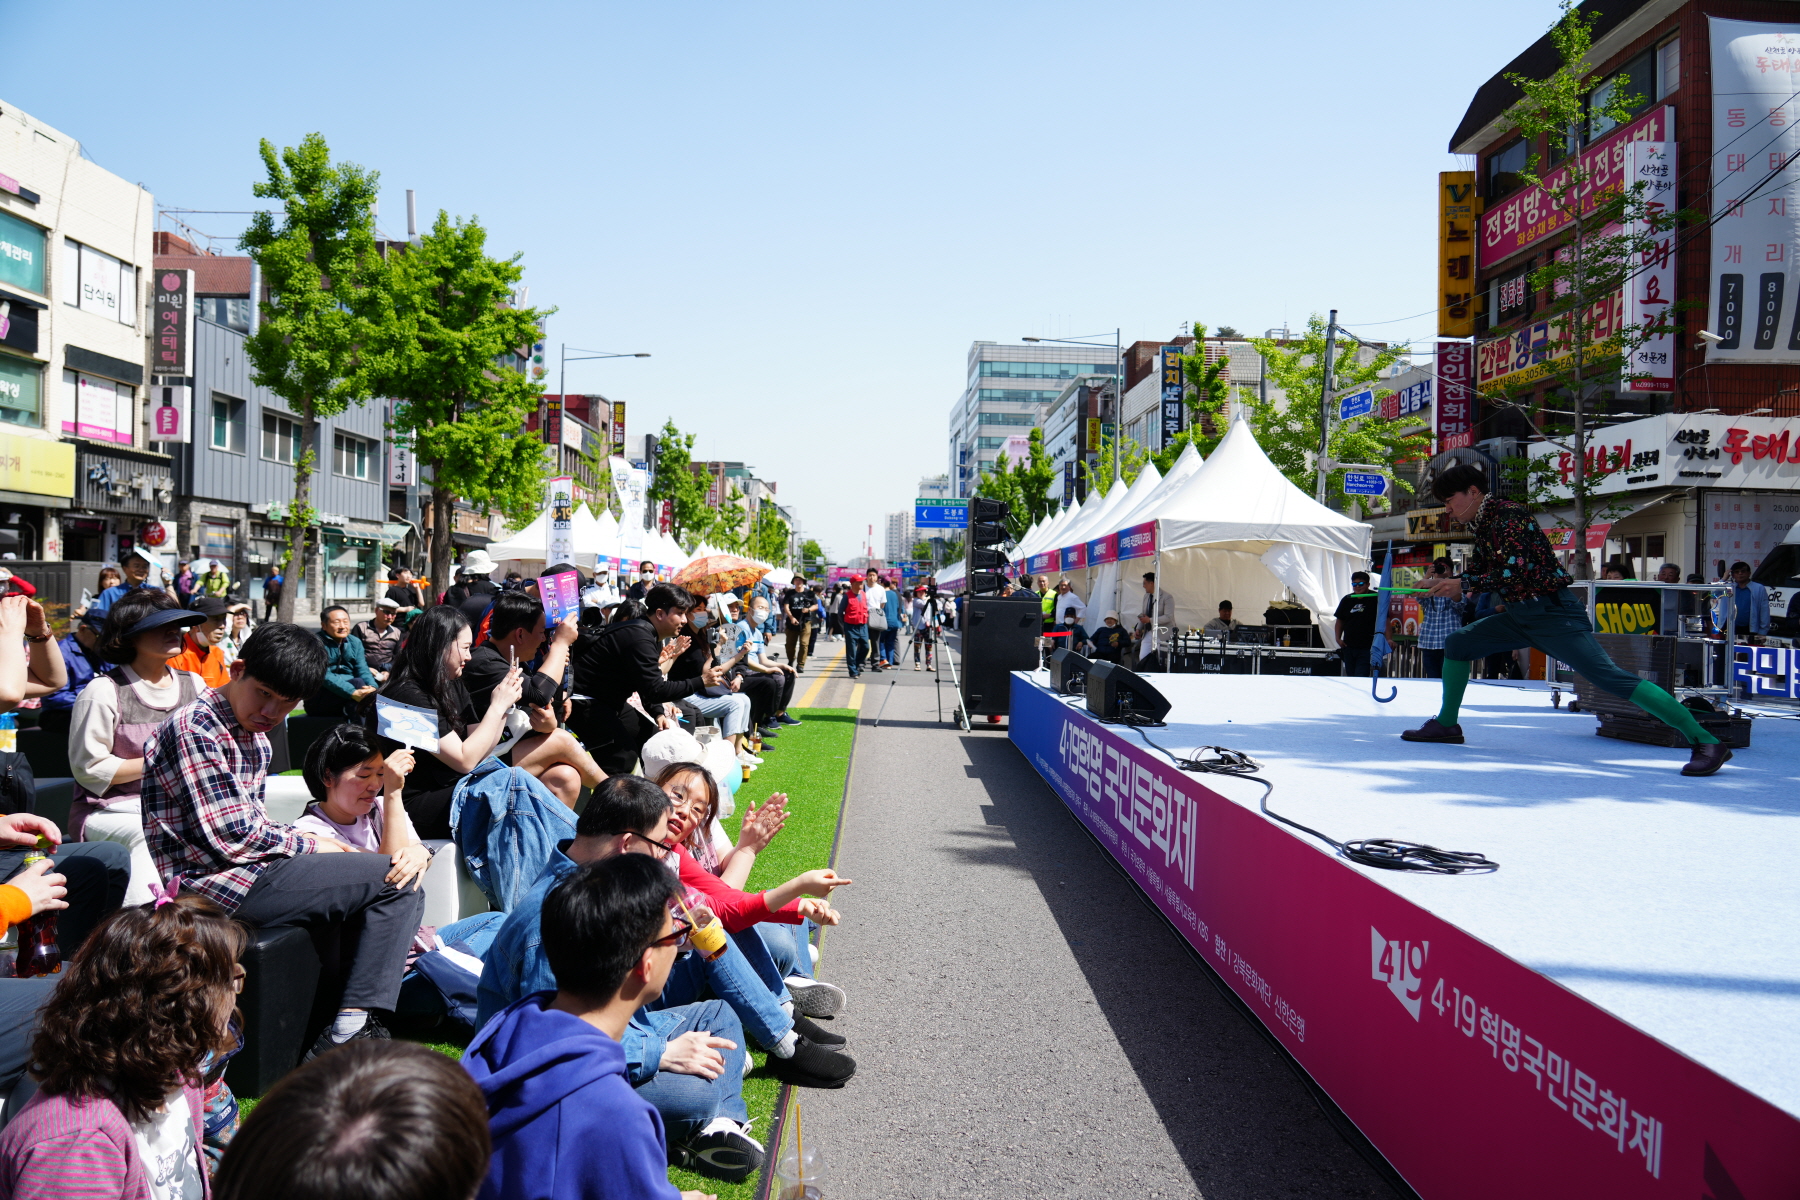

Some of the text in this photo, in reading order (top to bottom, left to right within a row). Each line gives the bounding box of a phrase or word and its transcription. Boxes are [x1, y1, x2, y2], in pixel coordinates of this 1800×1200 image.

[1639, 164, 1669, 177] 산천골
[0, 240, 32, 266] 체관리
[158, 294, 183, 309] 미원
[1500, 274, 1524, 312] 전화방
[161, 311, 178, 364] 에스테틱
[1638, 351, 1667, 364] 전문점
[1441, 343, 1467, 437] 성인전화방
[163, 409, 172, 432] NAIL
[1445, 434, 1469, 449] 7080
[944, 508, 964, 517] 도봉로
[1773, 504, 1800, 513] 25,000
[1596, 602, 1655, 634] SHOW
[1733, 646, 1800, 698] 국민
[1104, 744, 1198, 892] 국민문화제
[1197, 918, 1209, 942] KBS
[1214, 933, 1227, 962] 협찬
[1233, 952, 1272, 1008] 강북문화재단
[1274, 994, 1305, 1043] 신한은행
